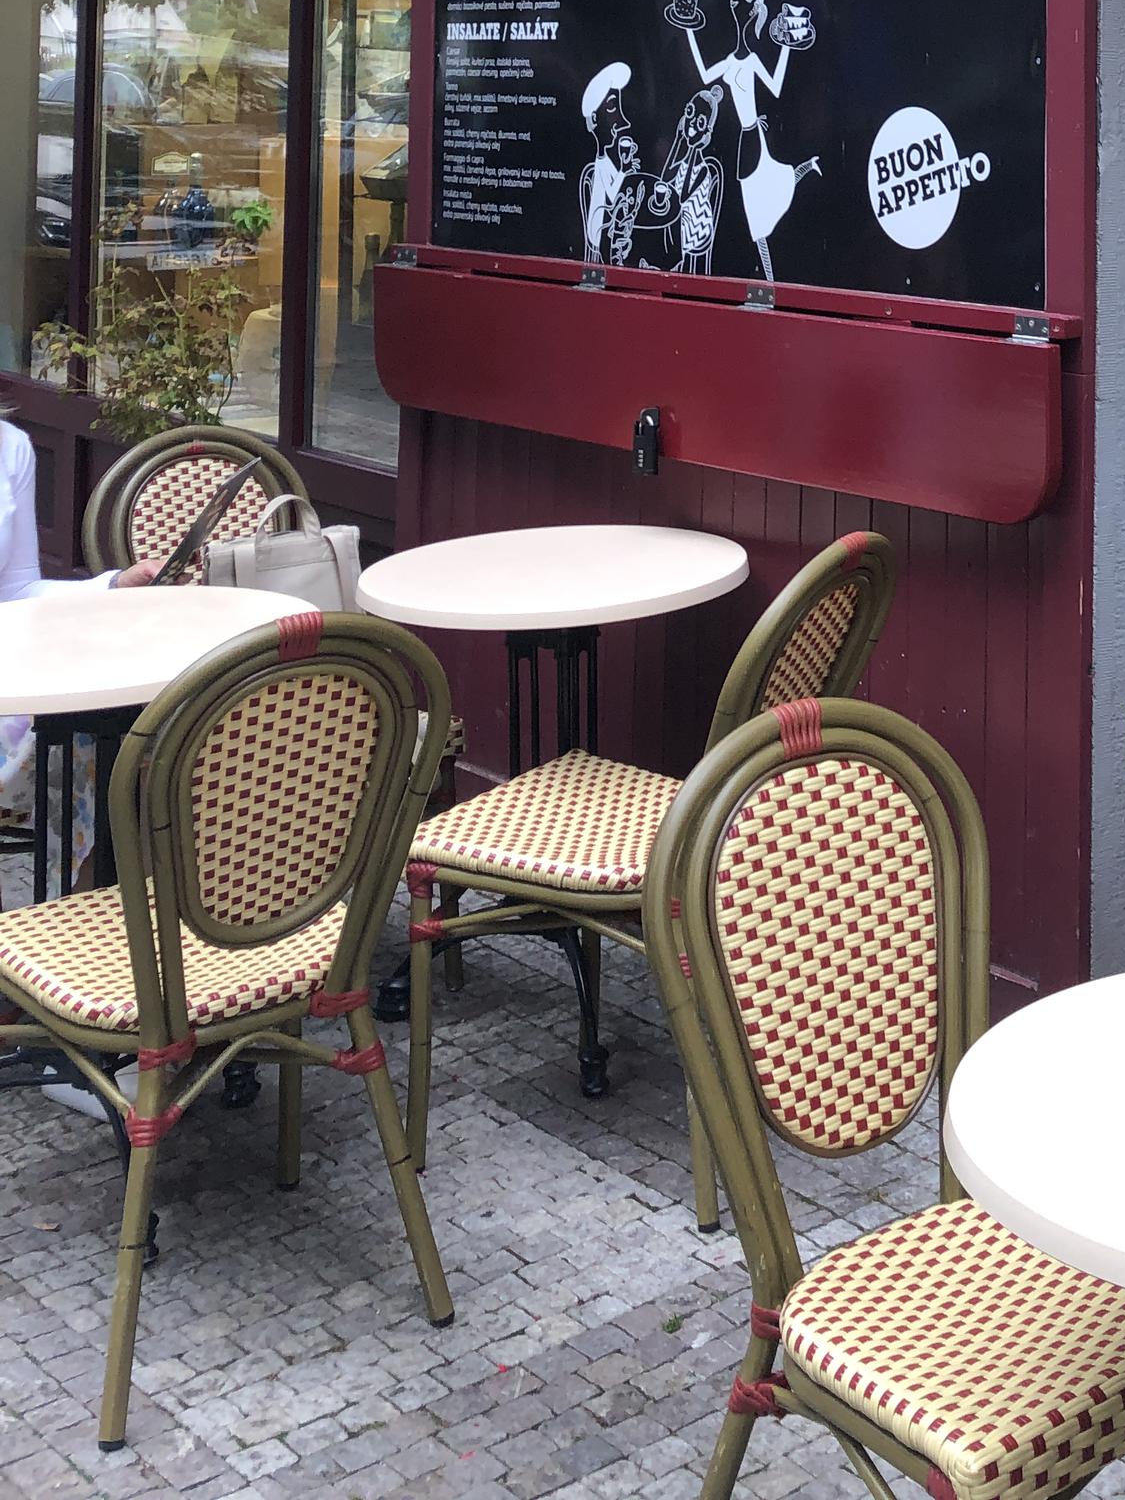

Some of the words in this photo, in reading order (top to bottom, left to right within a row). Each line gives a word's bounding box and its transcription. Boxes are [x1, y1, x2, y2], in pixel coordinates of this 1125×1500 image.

[446, 22, 500, 40] INSALATE
[510, 16, 559, 40] SALÁTY
[874, 133, 944, 185] BUON
[877, 152, 991, 218] APPETITO
